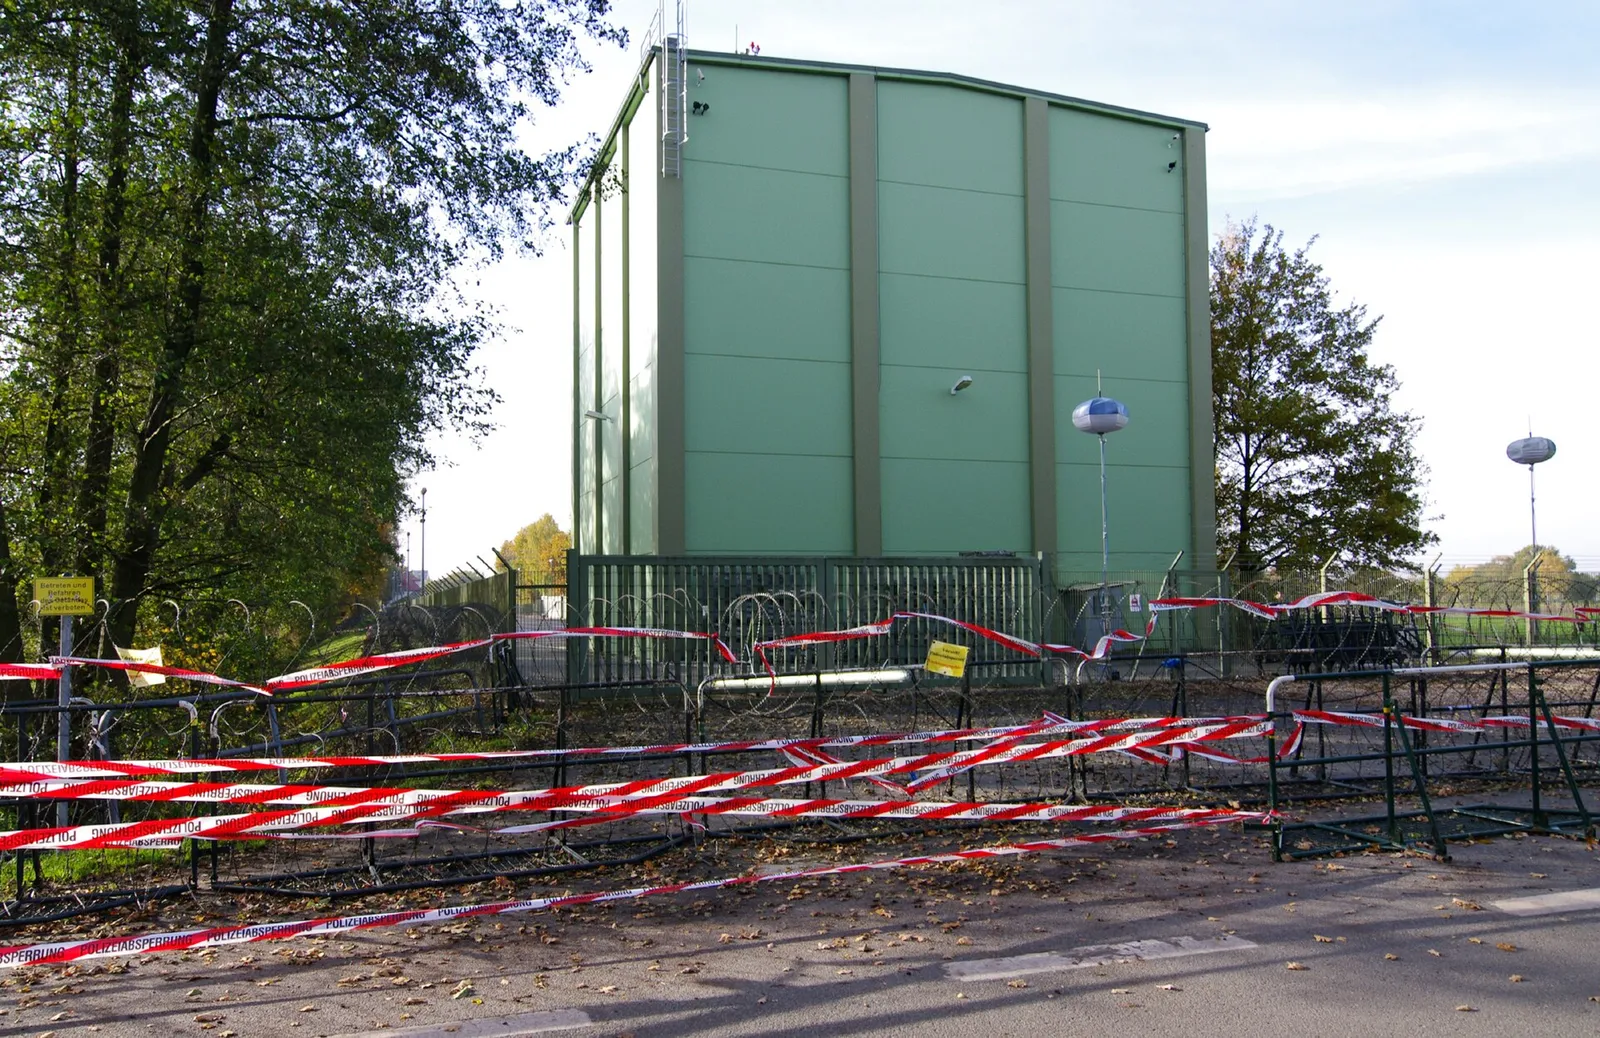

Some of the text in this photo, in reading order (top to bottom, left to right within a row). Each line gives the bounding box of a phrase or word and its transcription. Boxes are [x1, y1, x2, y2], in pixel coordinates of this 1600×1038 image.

[294, 661, 376, 683] POLIZEIABSPERRUNG
[63, 782, 174, 797] POLIZEIABSPERRUNG
[188, 788, 293, 801] POLIZEIABSPERRUNG
[306, 790, 405, 804] POLIZEIABSPERRUNG
[621, 799, 705, 812] POLIZEIABSPERRUNG
[715, 802, 795, 813] POLIZEIABSPERRUNG
[803, 803, 879, 815] POLIZEIABSPERRUNG
[215, 811, 319, 830] POLIZEIABSPERRUNG
[91, 821, 201, 840] POLIZEIABSPERRUNG
[80, 933, 193, 956] POLIZEIABSPERRUNG
[206, 921, 313, 942] POLIZEIABSPERRUNG
[325, 911, 426, 930] POLIZEIABSPERRUNG
